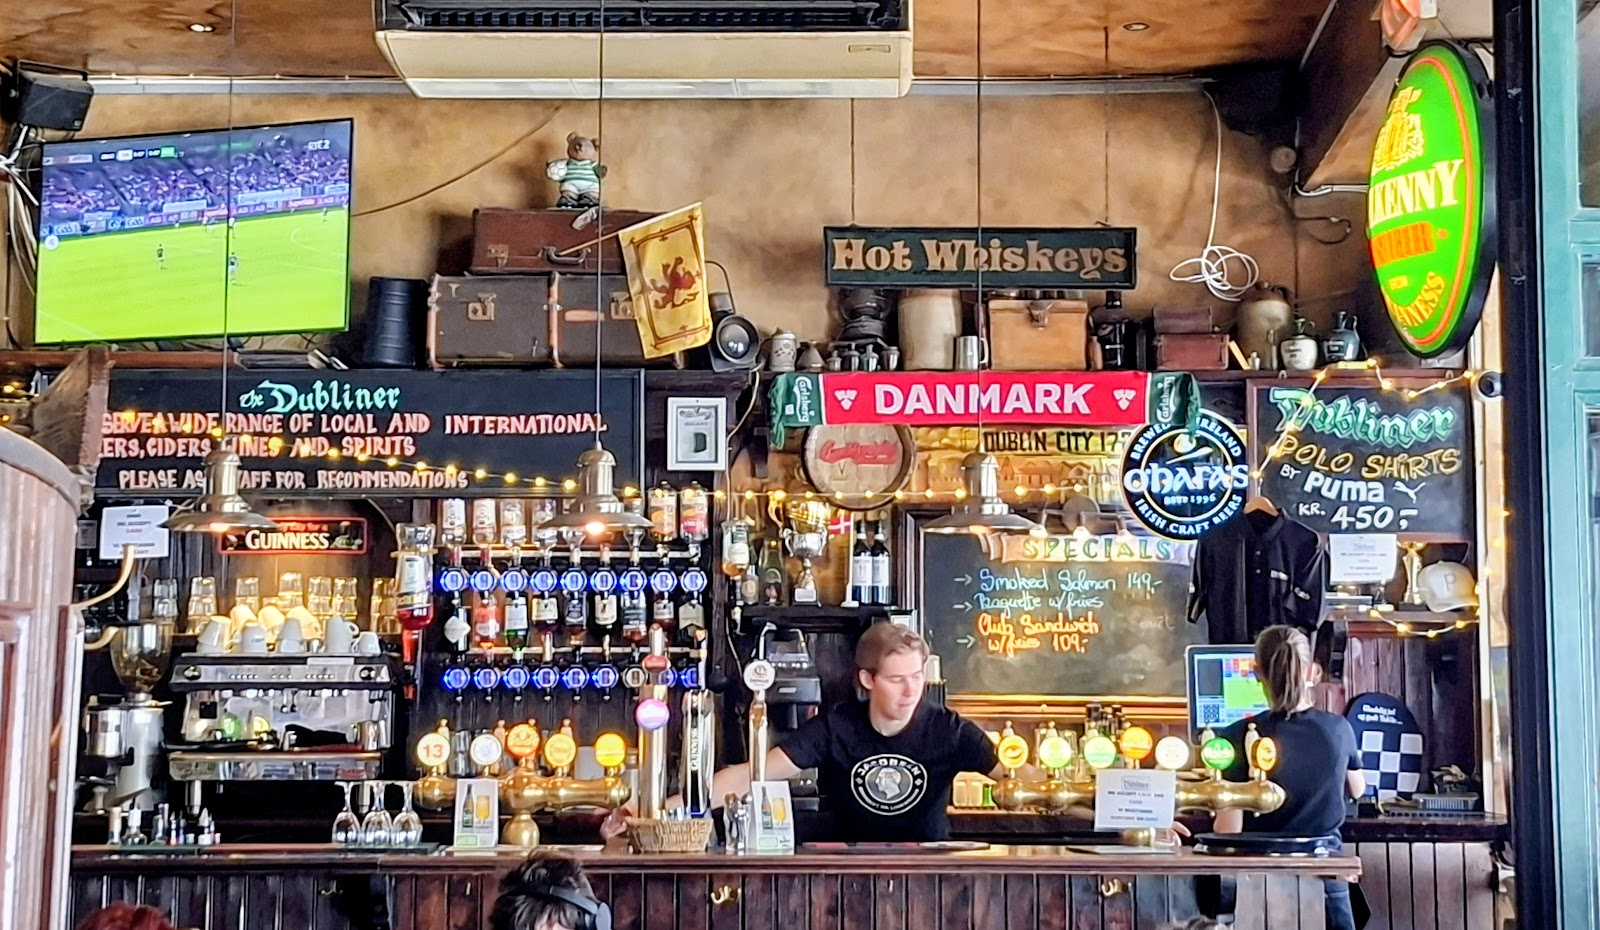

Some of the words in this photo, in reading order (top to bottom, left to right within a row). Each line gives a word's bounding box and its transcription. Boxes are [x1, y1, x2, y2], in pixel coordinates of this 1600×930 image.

[832, 238, 912, 271] Hot
[921, 238, 1127, 279] Whiskeys
[257, 379, 400, 412] Dubliner
[793, 376, 812, 422] Carlsberg
[874, 383, 1095, 415] DANMARK
[1156, 376, 1176, 422] Carlsberg
[101, 411, 154, 434] SERVE
[167, 411, 220, 434] WIDE
[225, 412, 283, 433] RANGE
[289, 412, 314, 433] OF
[321, 413, 377, 434] LOCAL
[387, 412, 430, 434] AND
[445, 413, 607, 435] INTERNATIONAL
[1269, 387, 1459, 448] Dubliner
[98, 437, 145, 459] ERS,
[289, 436, 330, 458] AND
[342, 435, 415, 458] SPIRITS
[983, 431, 1047, 452] DUBLIN
[1056, 431, 1094, 452] CITY
[1278, 435, 1354, 474] POLO
[119, 469, 177, 489] PLEASE
[182, 469, 206, 489] AS
[276, 471, 306, 489] FOR
[317, 470, 470, 489] RECOMMENDATIONS
[1280, 464, 1301, 479] BY
[1191, 493, 1216, 504] 1996
[1298, 503, 1326, 516] KR.
[1135, 498, 1167, 529] IRISH
[1168, 521, 1210, 535] CRAFT
[1212, 494, 1243, 524] BEERS
[245, 529, 330, 549] GUINNESS
[1022, 538, 1171, 560] SPECIALS
[979, 568, 1049, 592] Smoked
[1057, 569, 1117, 591] Salmon
[974, 592, 1041, 616] Baguette
[978, 612, 1014, 636] Club
[1019, 611, 1100, 635] Sandwich
[422, 744, 443, 758] 13
